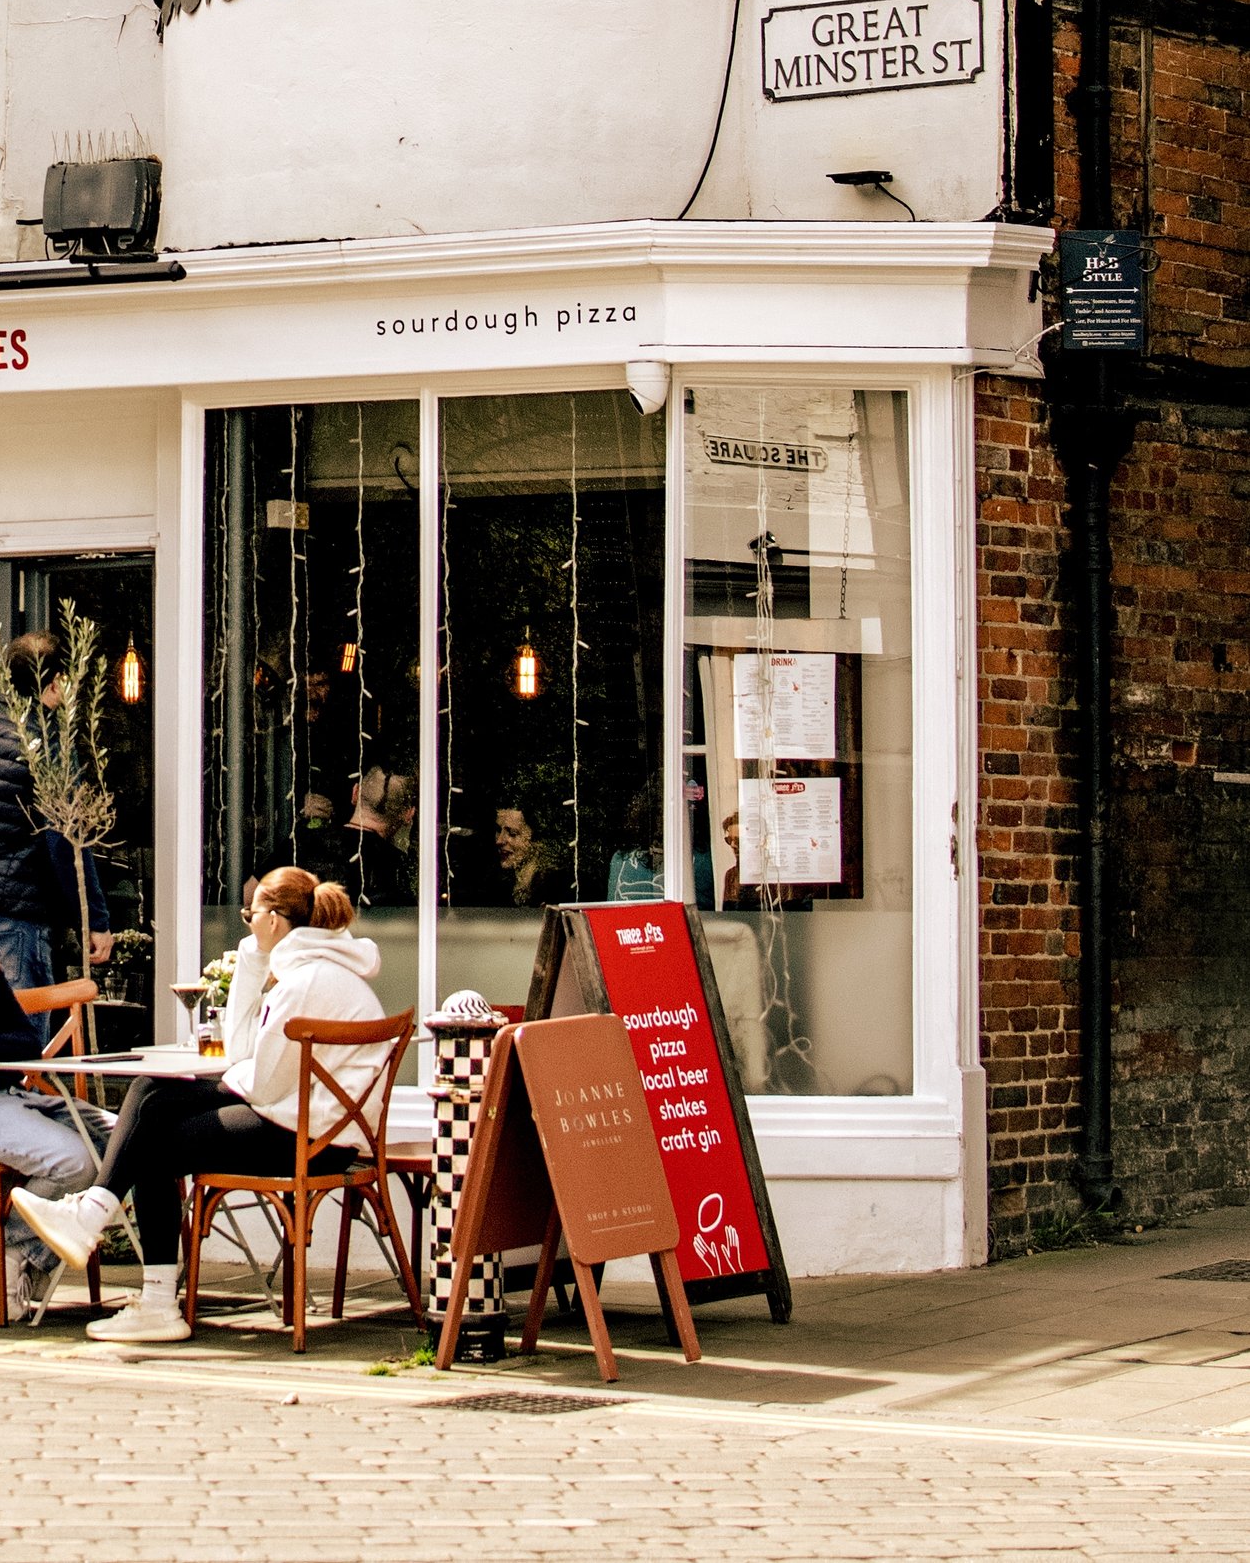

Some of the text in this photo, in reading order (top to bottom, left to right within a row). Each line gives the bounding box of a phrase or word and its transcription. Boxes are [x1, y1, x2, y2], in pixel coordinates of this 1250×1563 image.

[812, 4, 928, 47] GREAT
[774, 38, 973, 89] MINSTER ST
[376, 303, 636, 335] sourdough pizza
[643, 922, 665, 943] JOES
[623, 1002, 698, 1031] sourdough
[649, 1037, 687, 1065] pizza
[639, 1065, 709, 1092] local beer
[555, 1082, 625, 1107] JOANNE
[659, 1096, 708, 1121] shakes
[559, 1108, 632, 1133] BOWLES
[660, 1124, 722, 1153] craft gin
